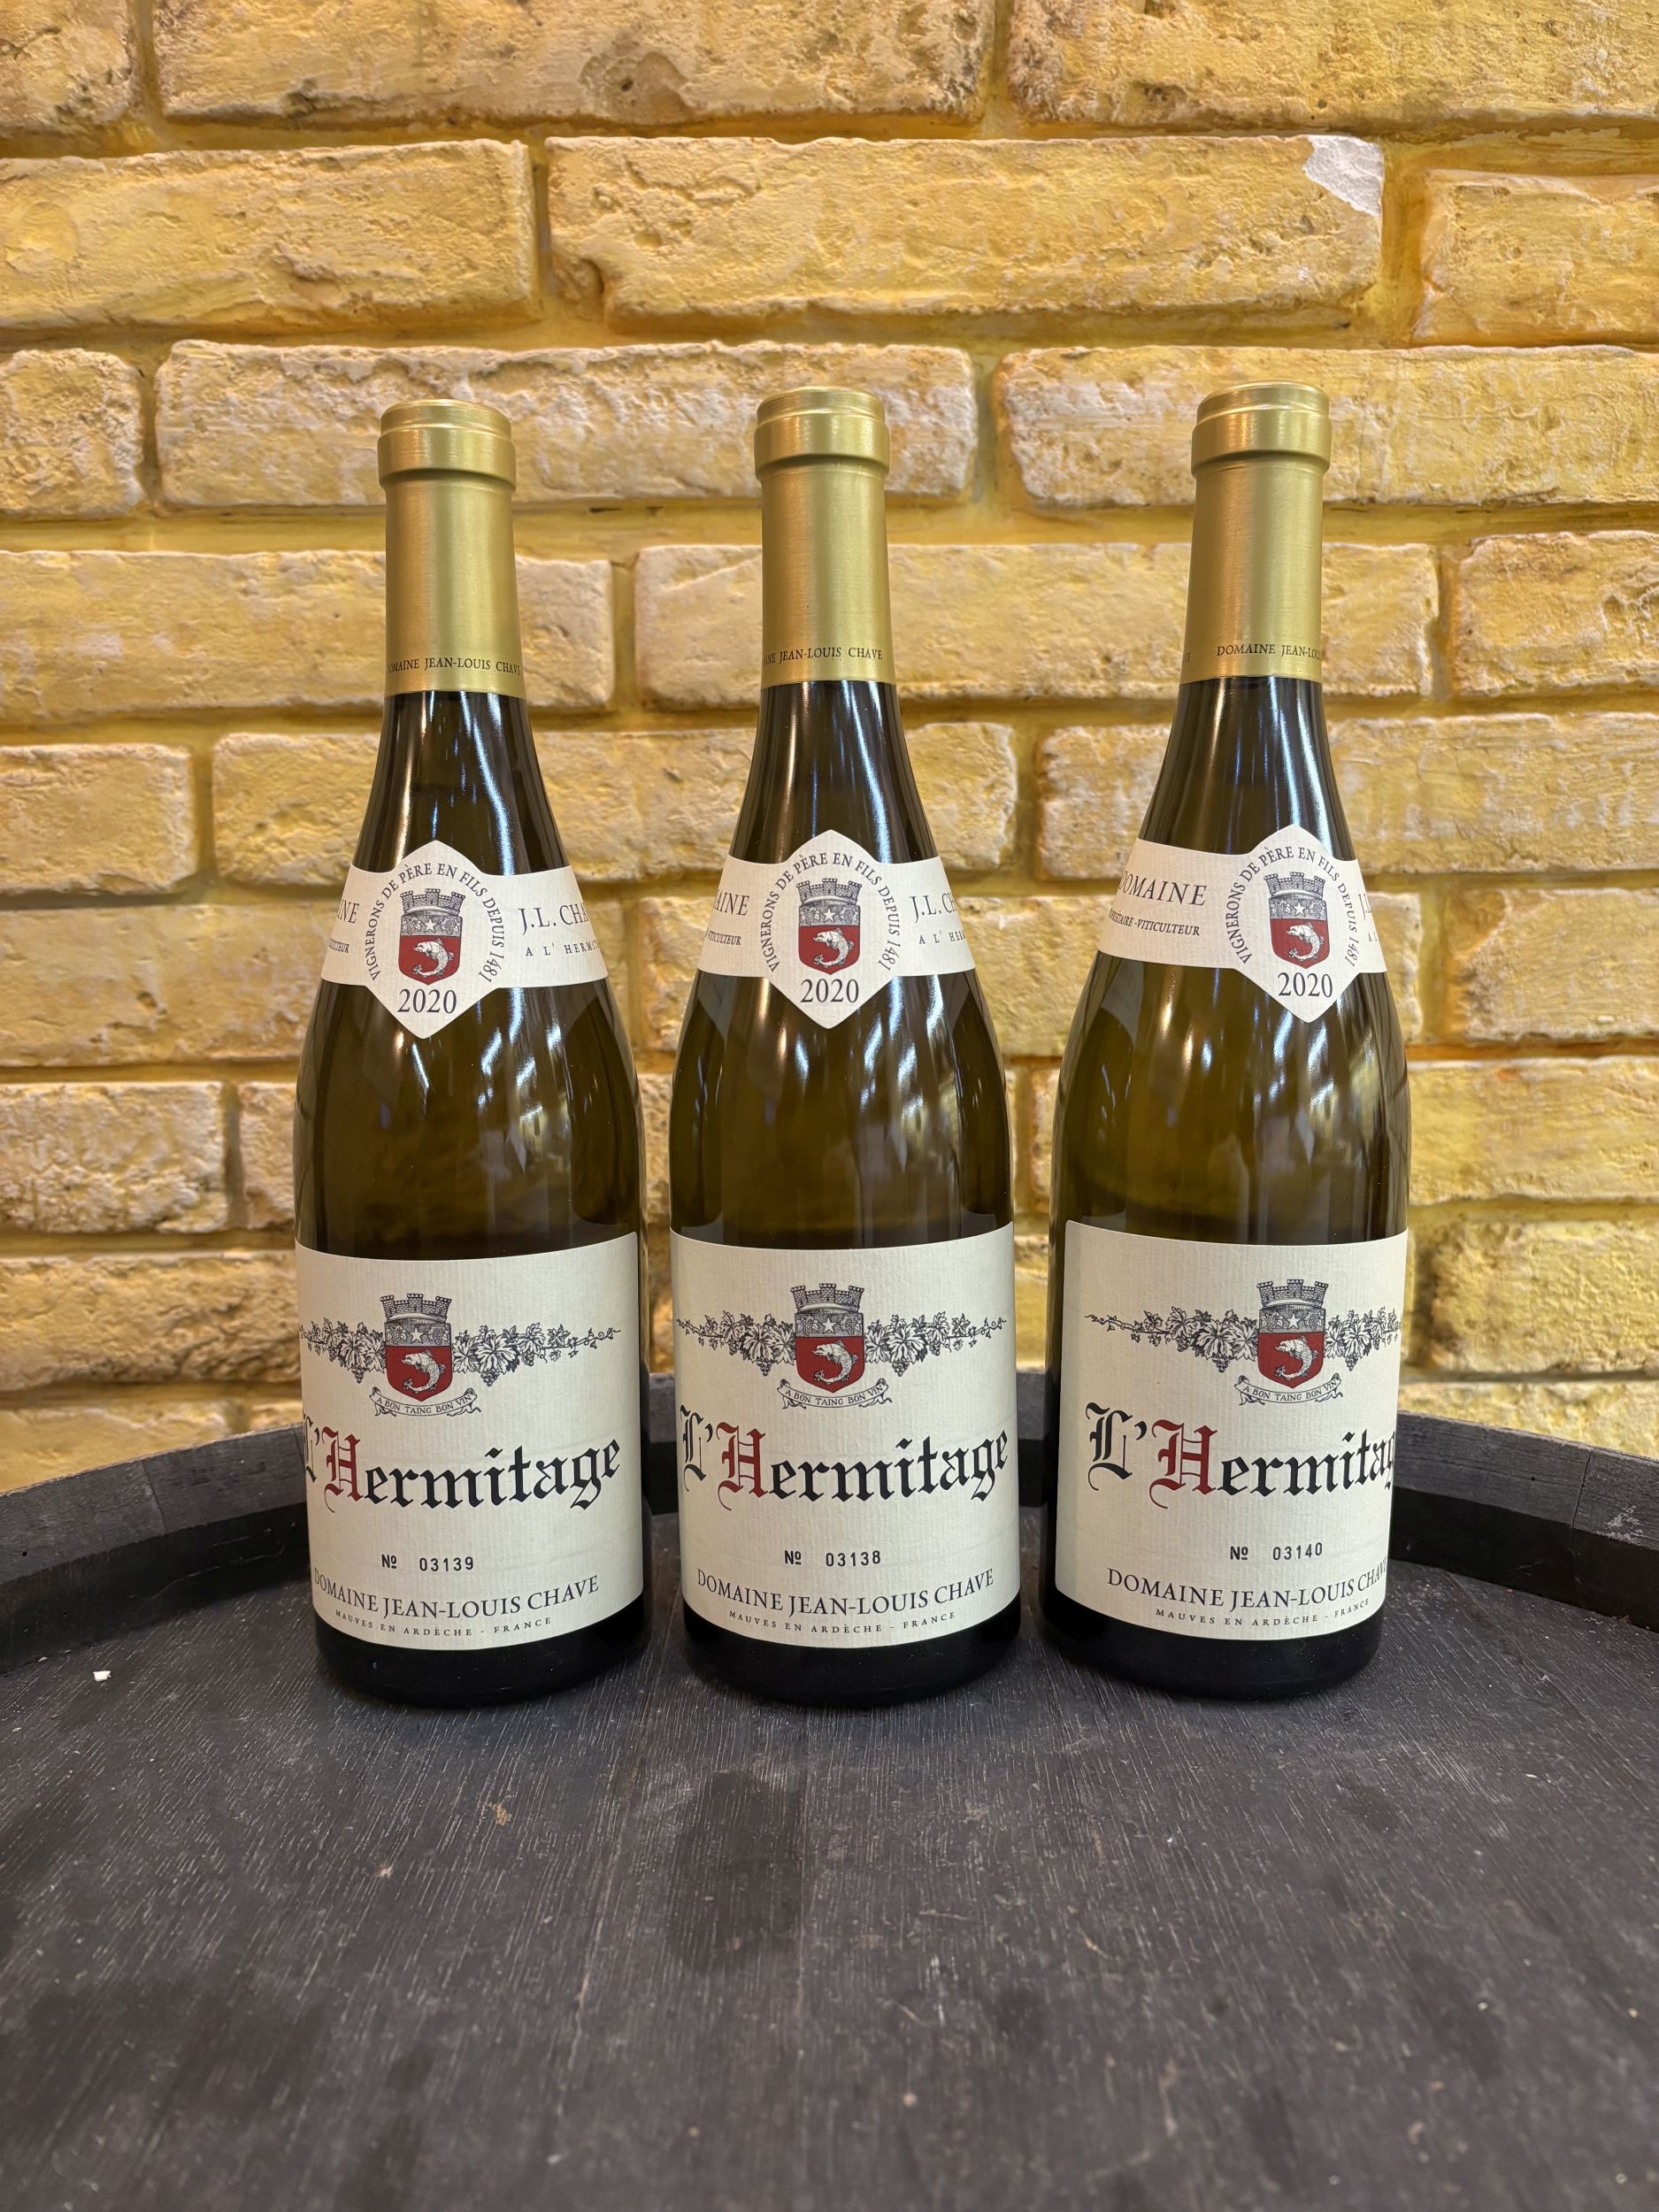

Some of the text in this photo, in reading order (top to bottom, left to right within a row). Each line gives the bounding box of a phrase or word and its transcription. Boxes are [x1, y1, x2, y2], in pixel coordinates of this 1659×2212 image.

[779, 647, 842, 664] JEAN-LOUIS
[848, 647, 883, 660] CHAVE
[1217, 643, 1276, 657] DOMAINE
[425, 657, 491, 672] JEAN-LOUIS
[400, 863, 433, 885] PÈRE
[436, 863, 458, 879] EN
[458, 871, 488, 897] FILS
[382, 879, 399, 900] DE
[1118, 871, 1207, 906] DOMAINE
[760, 852, 901, 972] VIGNERONS DE PÈRE EN FILS DEPUIS 1481
[910, 895, 941, 924] J.L.
[1225, 846, 1359, 967] VIGNERONS DE PÈRE EN FILS DEPUIS 1481
[482, 896, 505, 948] DEPUIS
[518, 907, 557, 935] J.L.
[365, 900, 385, 981] VIGNERONS
[526, 946, 534, 956] A
[918, 934, 926, 945] A
[478, 951, 505, 983] 1481
[800, 978, 859, 1003] 2020
[1277, 972, 1333, 998] 2020
[397, 988, 457, 1014] 2020
[794, 1391, 811, 1403] BON
[848, 1394, 866, 1404] BON
[867, 1384, 884, 1397] VIN
[1252, 1387, 1271, 1399] BON
[1305, 1388, 1322, 1399] BON
[1323, 1379, 1337, 1392] VIN
[384, 1399, 401, 1411] BON
[435, 1402, 454, 1413] BON
[455, 1394, 472, 1407] VIN
[680, 1404, 1009, 1511] L'Hermitage
[419, 1555, 474, 1572] 03139
[826, 1549, 882, 1567] 03138
[1272, 1541, 1323, 1561] 03140
[314, 1567, 599, 1619] DOMAINE JEAN-LOUIS CHAVE
[696, 1568, 994, 1617] DOMAINE JEAN-LOUIS CHAVE
[1107, 1567, 1225, 1608] DOMAINE
[1229, 1578, 1355, 1612] JEAN-LOUIS
[335, 1609, 374, 1628] MAUVES
[380, 1624, 396, 1632] EN
[403, 1626, 472, 1637] ARDÈCHE
[494, 1617, 551, 1633] FRANCE
[729, 1610, 777, 1628] MAUVES
[785, 1623, 803, 1632] EN
[810, 1623, 881, 1634] ARDÈCHE
[902, 1611, 956, 1629] FRANCE
[1156, 1608, 1216, 1624] MAUVES
[1251, 1615, 1318, 1626] ARDÈCHE
[1334, 1599, 1370, 1618] FRANCE
